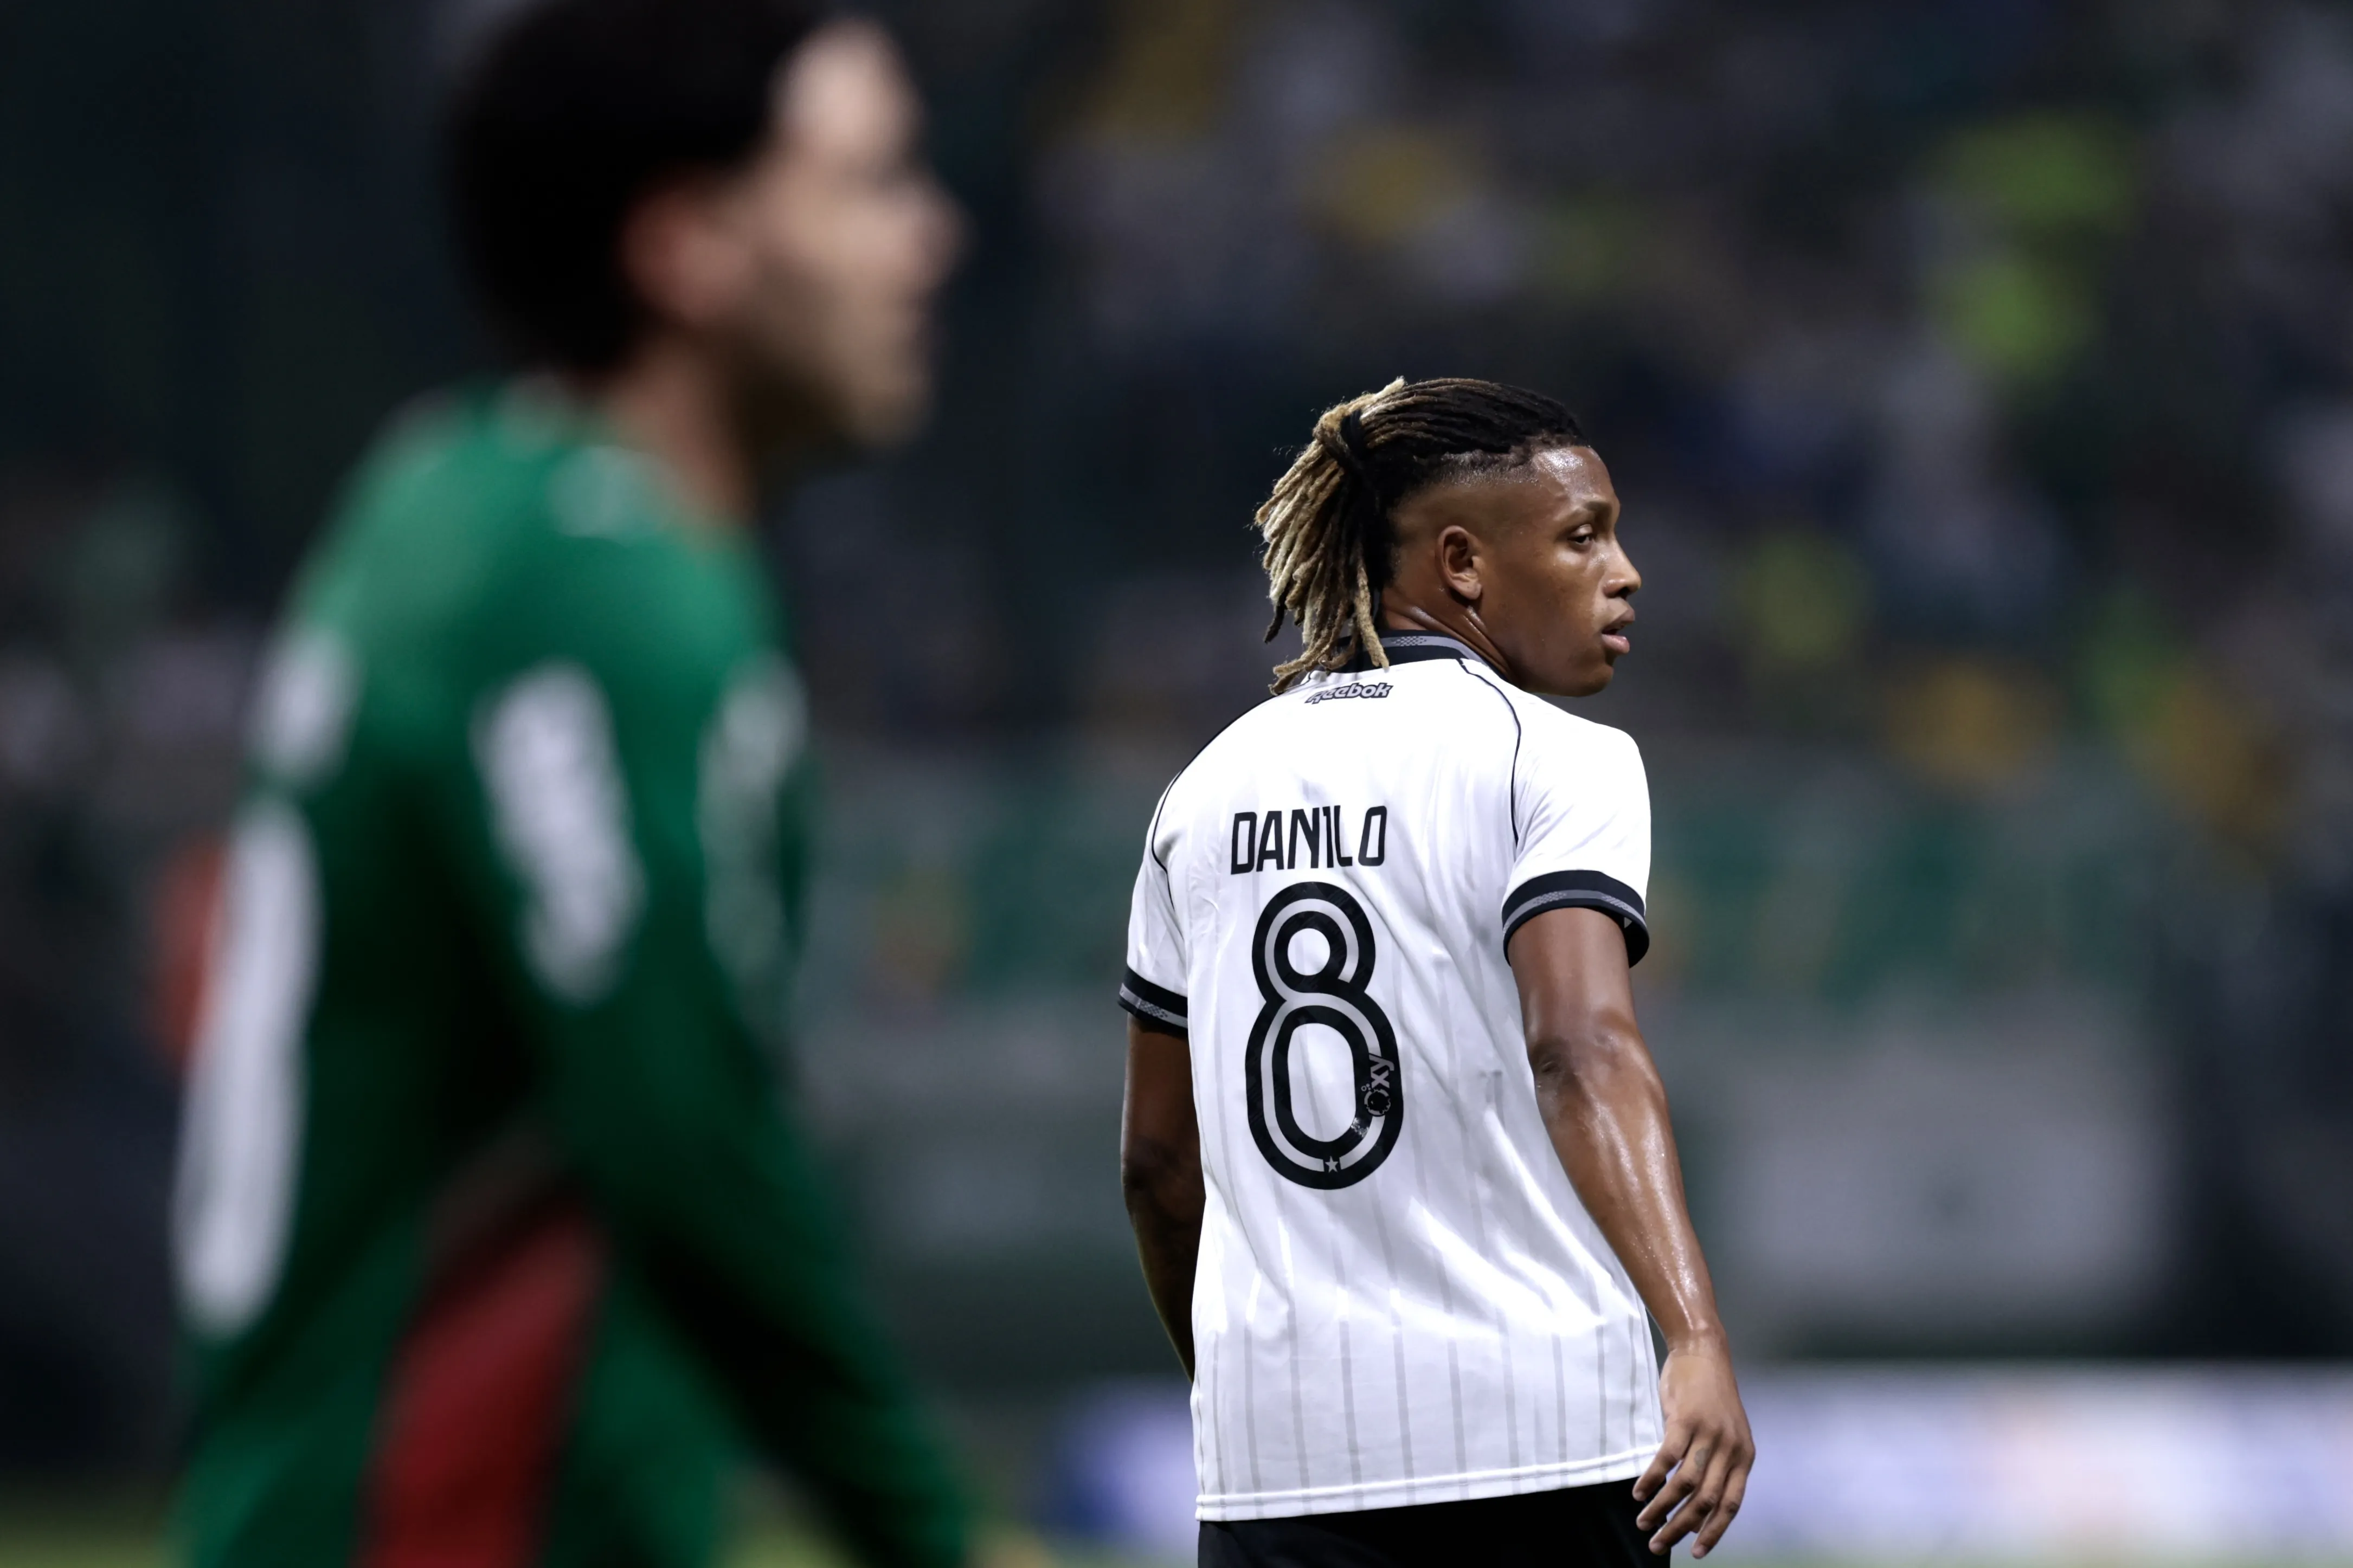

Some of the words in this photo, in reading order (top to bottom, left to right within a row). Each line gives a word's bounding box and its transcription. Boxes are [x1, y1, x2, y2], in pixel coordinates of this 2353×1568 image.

[1304, 682, 1394, 705] Reebok
[1231, 805, 1387, 875] DANILO
[1245, 881, 1404, 1190] 8
